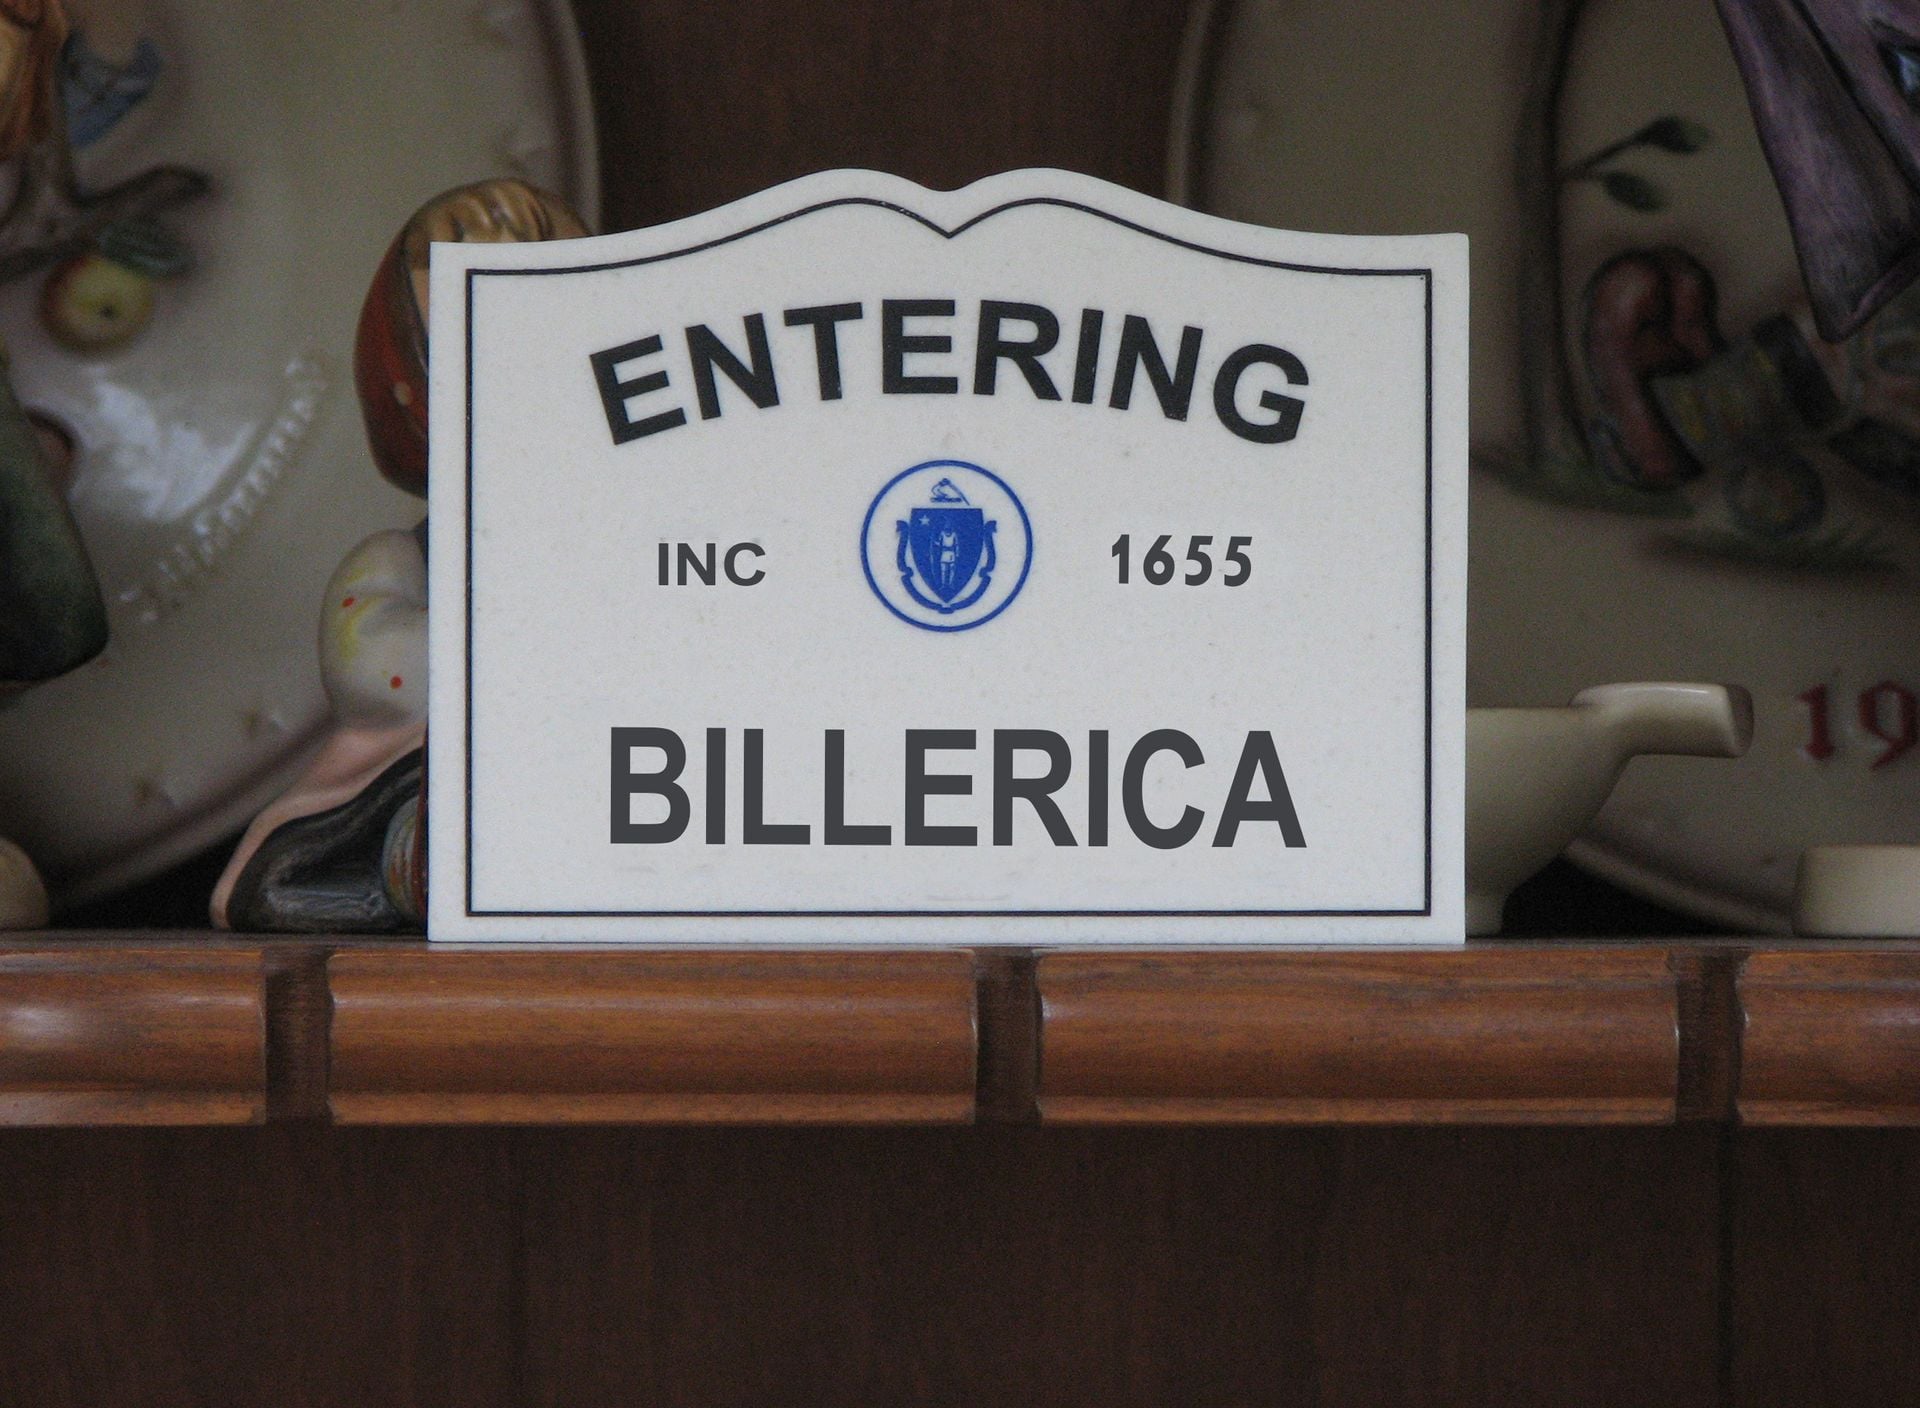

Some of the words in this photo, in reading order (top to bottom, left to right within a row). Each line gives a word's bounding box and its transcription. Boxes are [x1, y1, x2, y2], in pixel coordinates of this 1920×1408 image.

[589, 299, 1309, 445] ENTERING
[658, 542, 766, 587] INC
[1111, 534, 1253, 588] 1655
[610, 727, 1307, 849] BILLERICA
